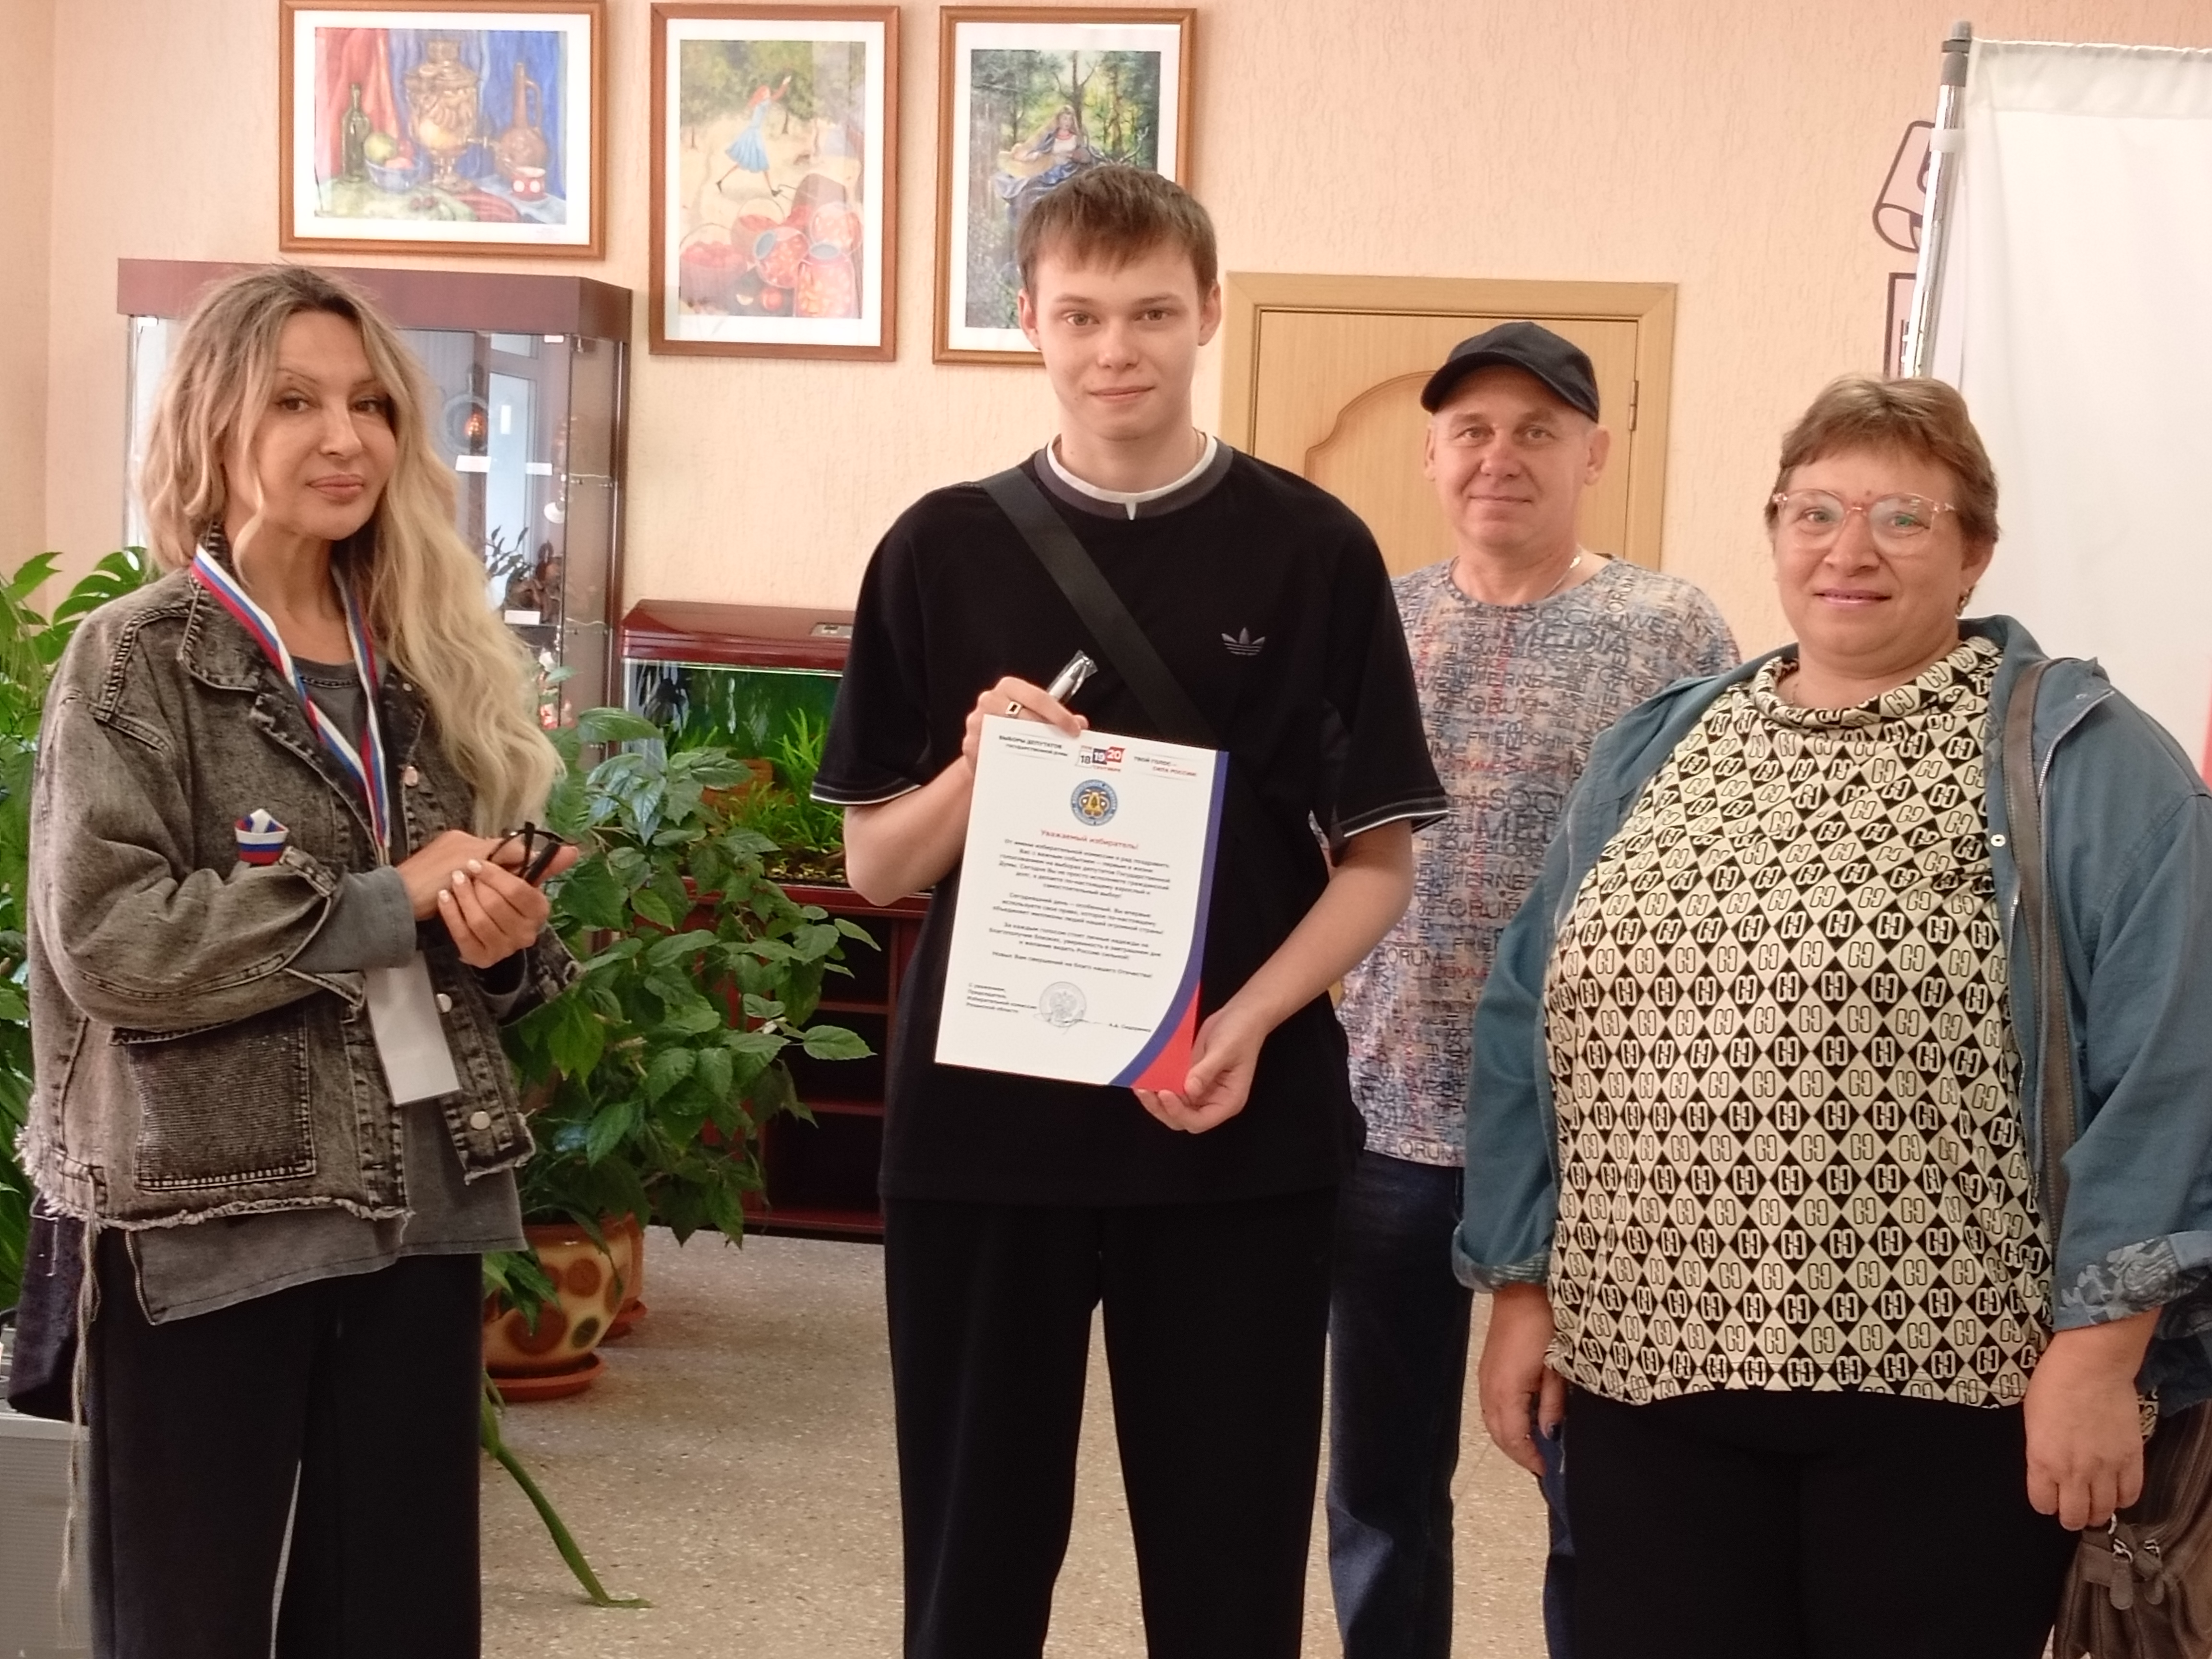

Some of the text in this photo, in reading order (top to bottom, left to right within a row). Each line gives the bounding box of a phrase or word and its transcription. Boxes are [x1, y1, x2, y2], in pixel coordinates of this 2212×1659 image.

[1081, 749, 1121, 764] 18 19 20
[1488, 788, 1563, 815] SOCI
